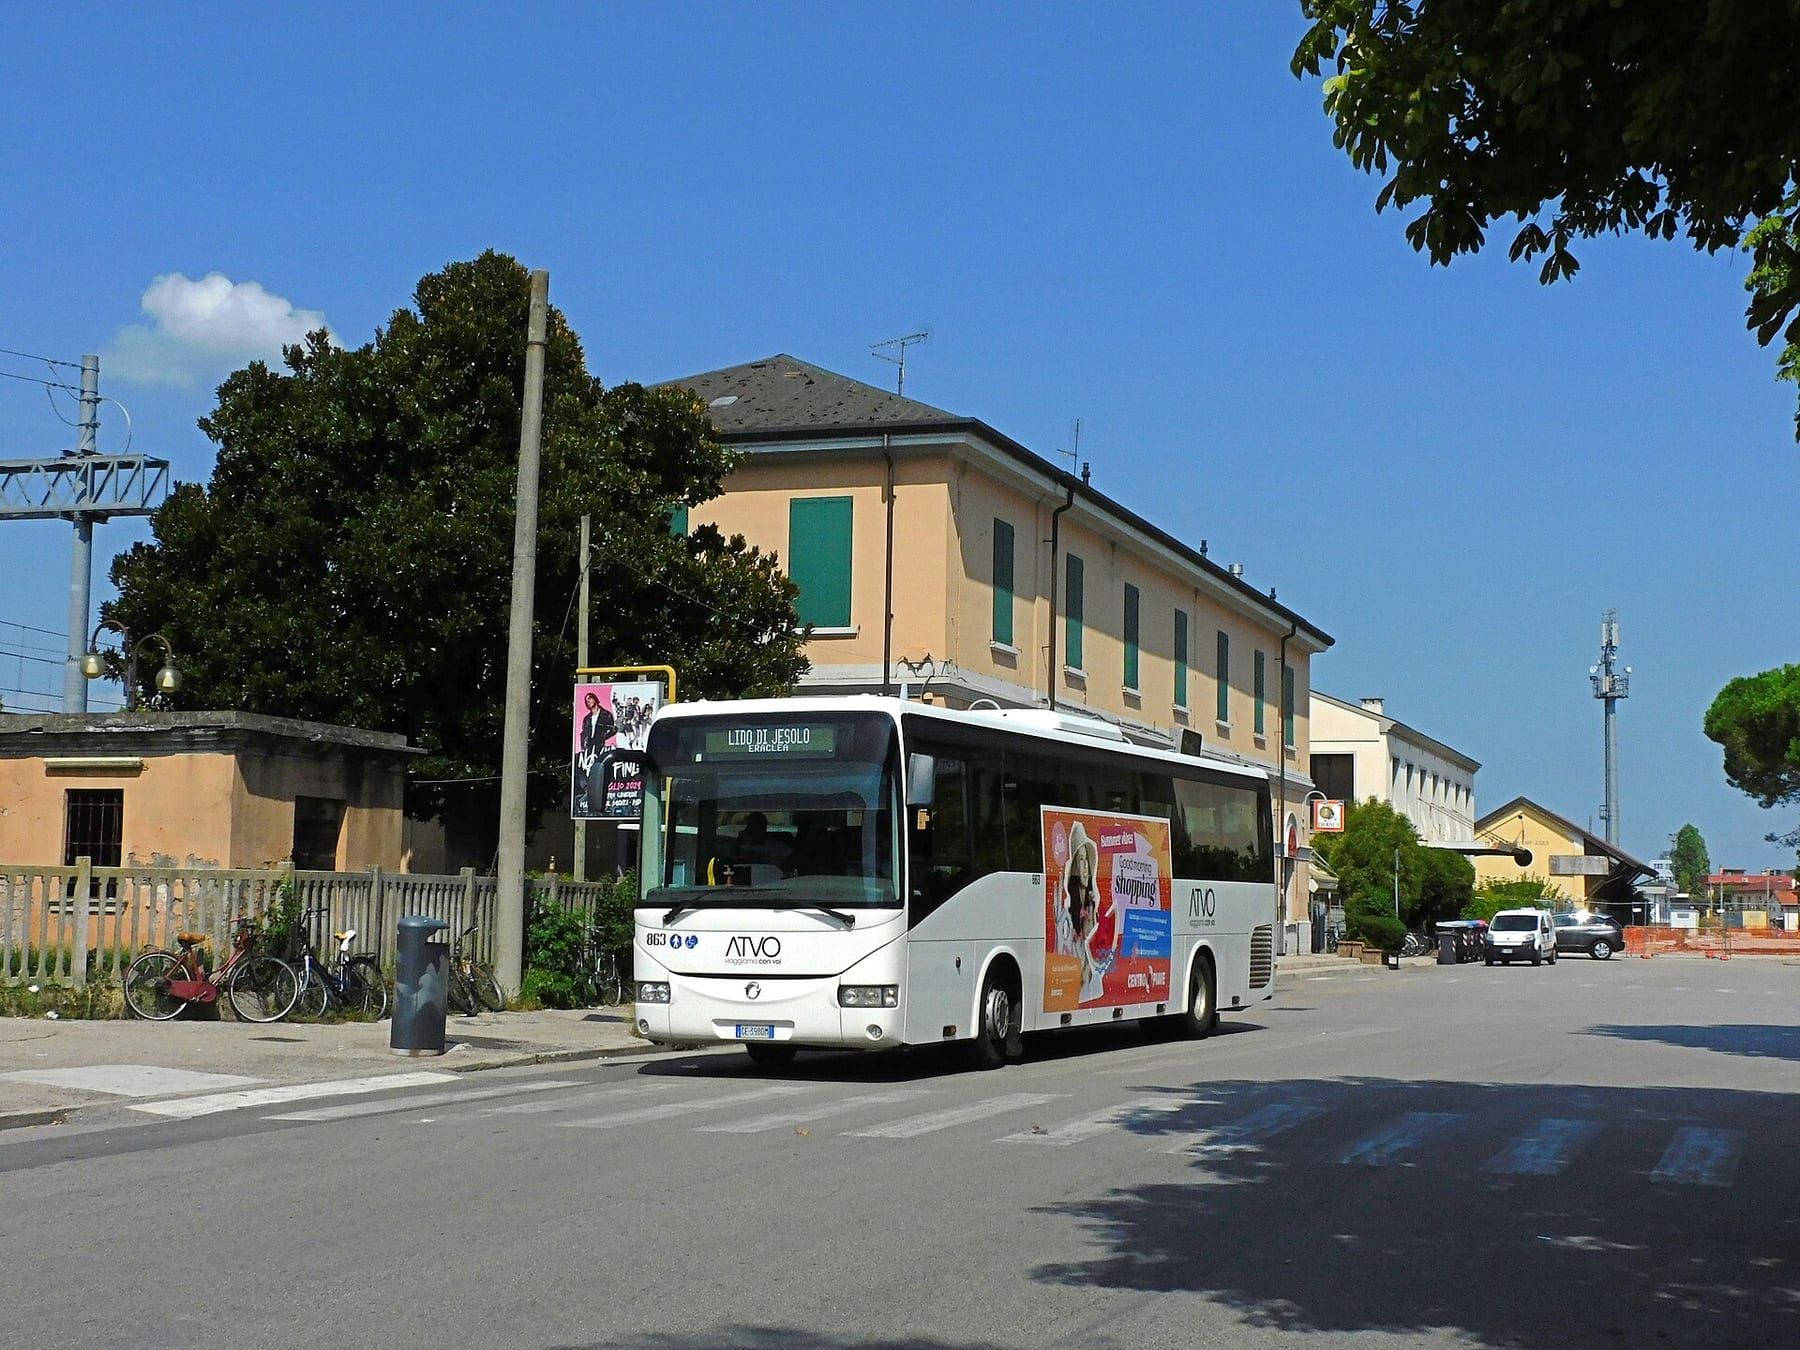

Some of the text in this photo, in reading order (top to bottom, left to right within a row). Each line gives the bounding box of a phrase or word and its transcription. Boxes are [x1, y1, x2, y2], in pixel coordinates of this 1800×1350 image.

[728, 728, 810, 746] LIDO DI JESOLO
[748, 743, 789, 753] ERACLEA
[1101, 834, 1121, 848] Summer
[1119, 855, 1152, 877] Good morning
[1032, 873, 1041, 886] 863
[1115, 869, 1157, 907] shopping
[1189, 888, 1215, 917] ATVO
[646, 933, 667, 946] 863
[725, 936, 781, 958] ATVO
[725, 957, 758, 966] viaggiamo
[772, 957, 782, 965] voi
